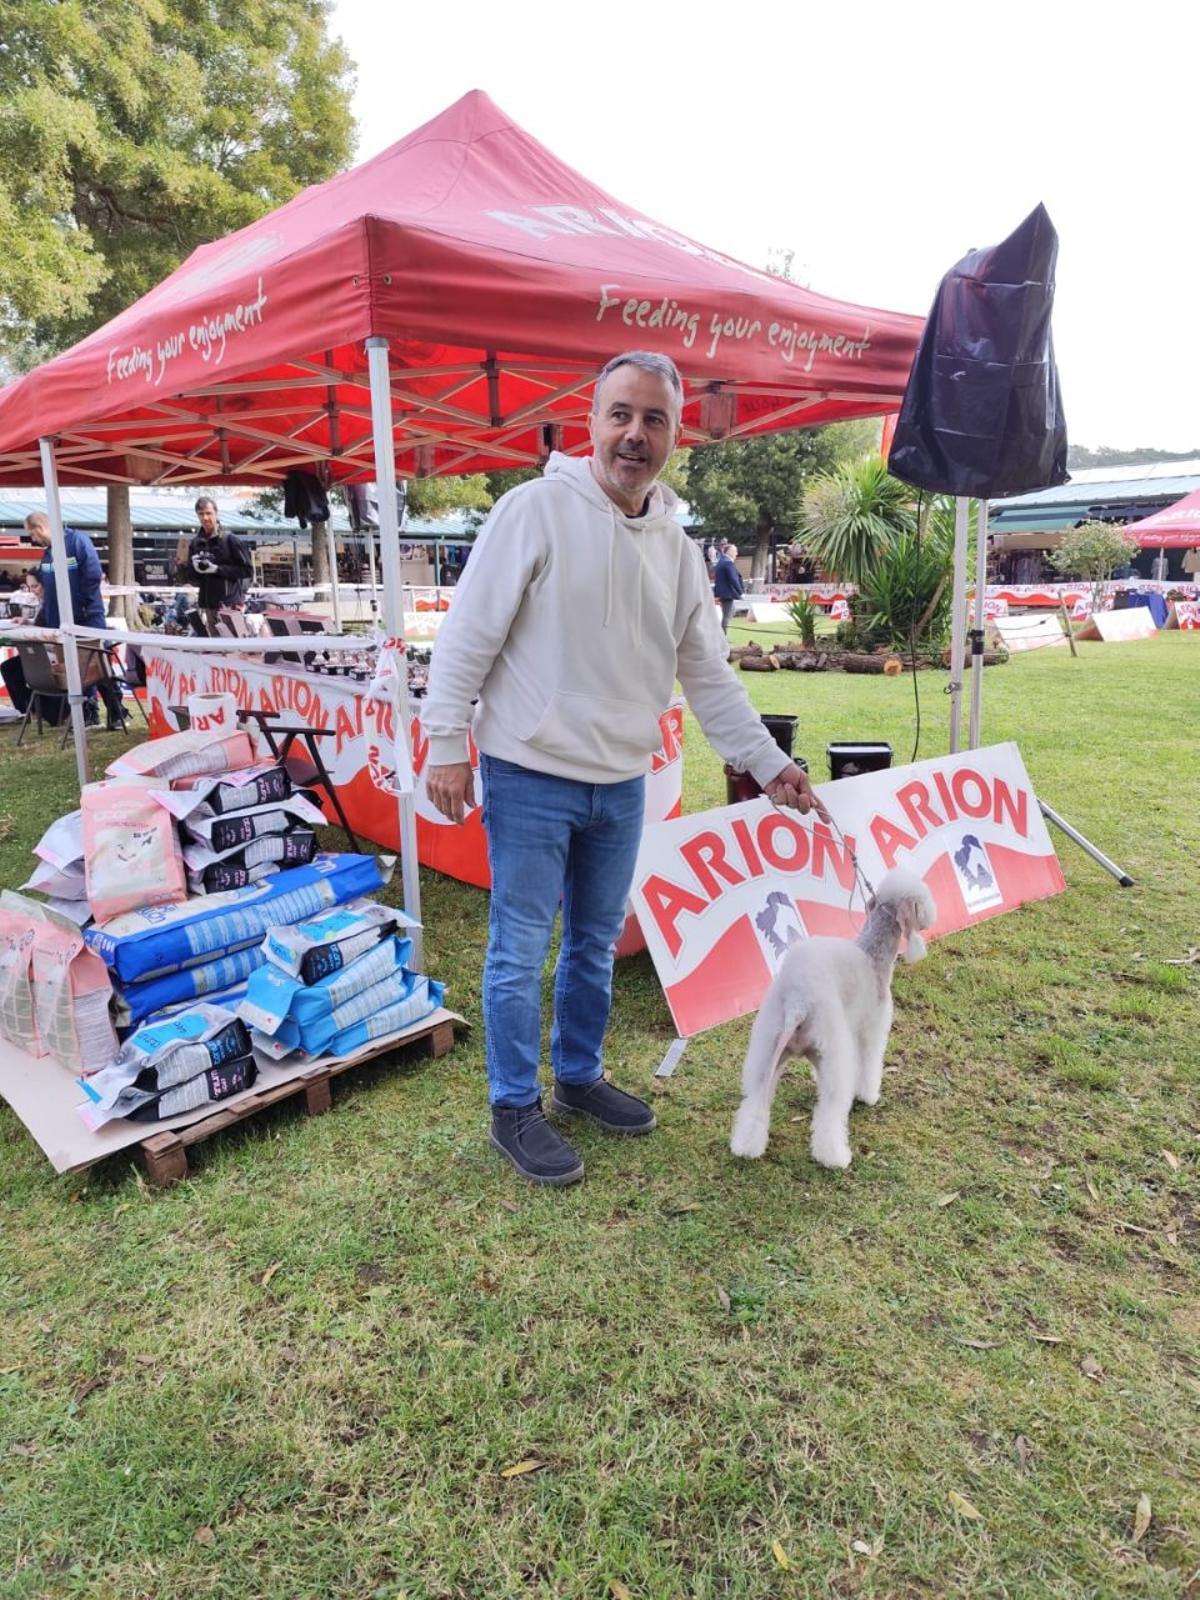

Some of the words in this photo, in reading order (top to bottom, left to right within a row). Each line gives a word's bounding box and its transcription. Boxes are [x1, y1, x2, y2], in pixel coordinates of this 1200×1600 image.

[107, 345, 153, 385] Feeding
[155, 332, 185, 386] your
[189, 275, 268, 365] enjoyment
[596, 284, 701, 348] Feeding
[706, 313, 761, 358] your
[768, 321, 871, 373] enjoyment
[258, 674, 329, 746] ARION
[870, 767, 1028, 869] ARION
[641, 813, 857, 959] ARION
